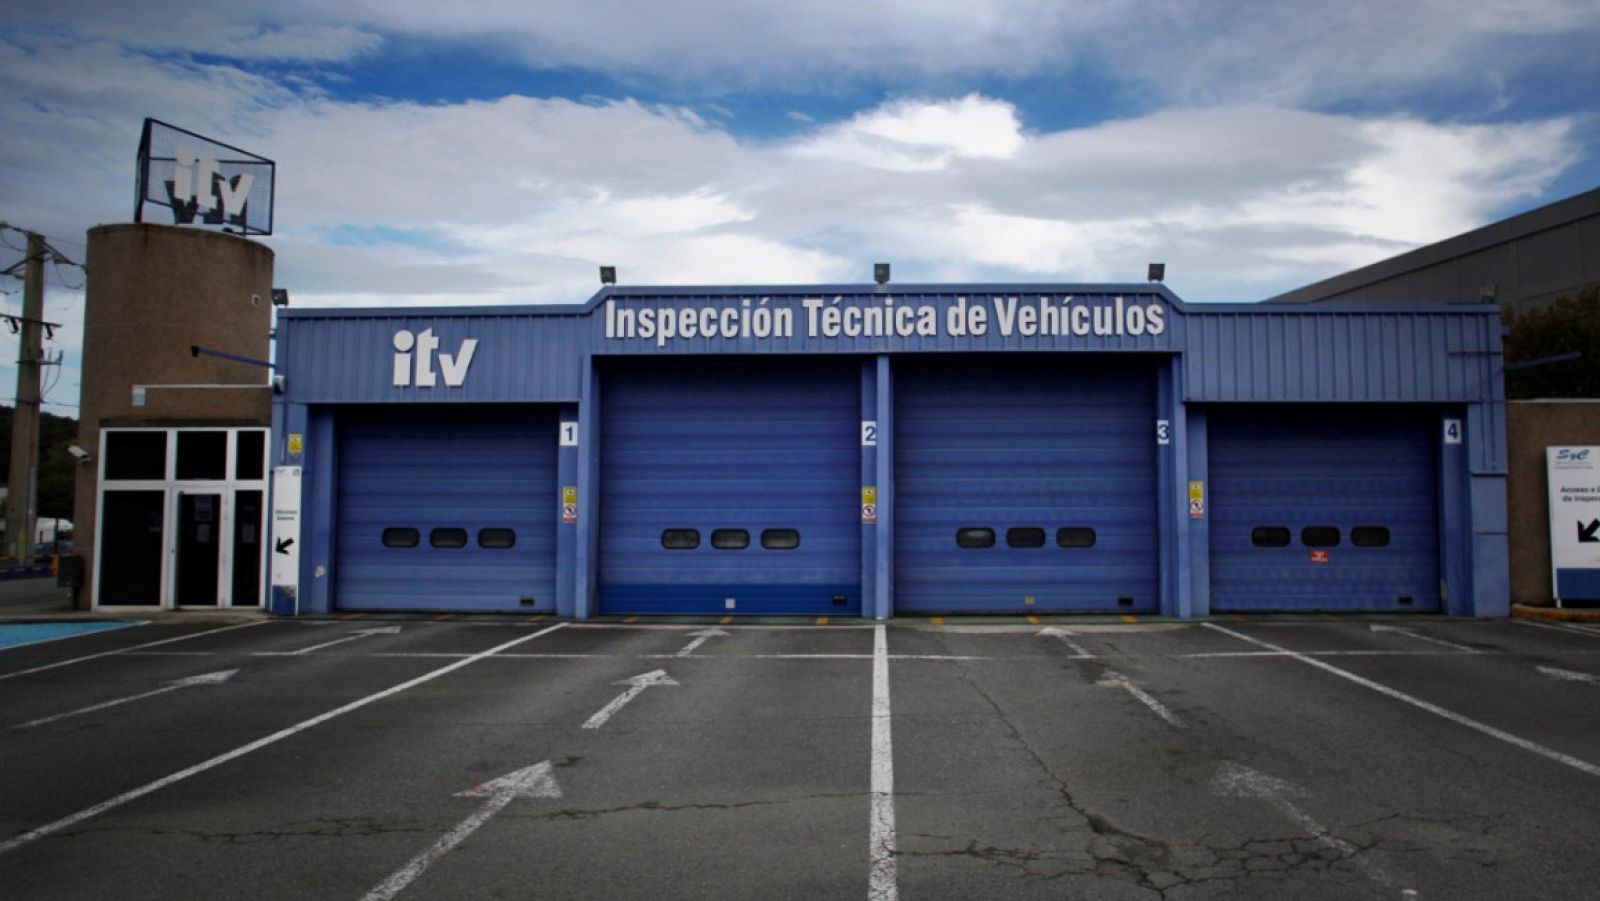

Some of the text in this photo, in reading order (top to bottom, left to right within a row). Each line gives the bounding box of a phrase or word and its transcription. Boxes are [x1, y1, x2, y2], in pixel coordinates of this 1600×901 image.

[173, 144, 255, 216] itv
[605, 296, 1165, 346] Inspección Técnica de Vehículos
[392, 327, 479, 387] itv
[565, 426, 573, 442] 1
[865, 425, 877, 441] 2
[1157, 424, 1169, 440] 3
[1447, 423, 1458, 439] 4
